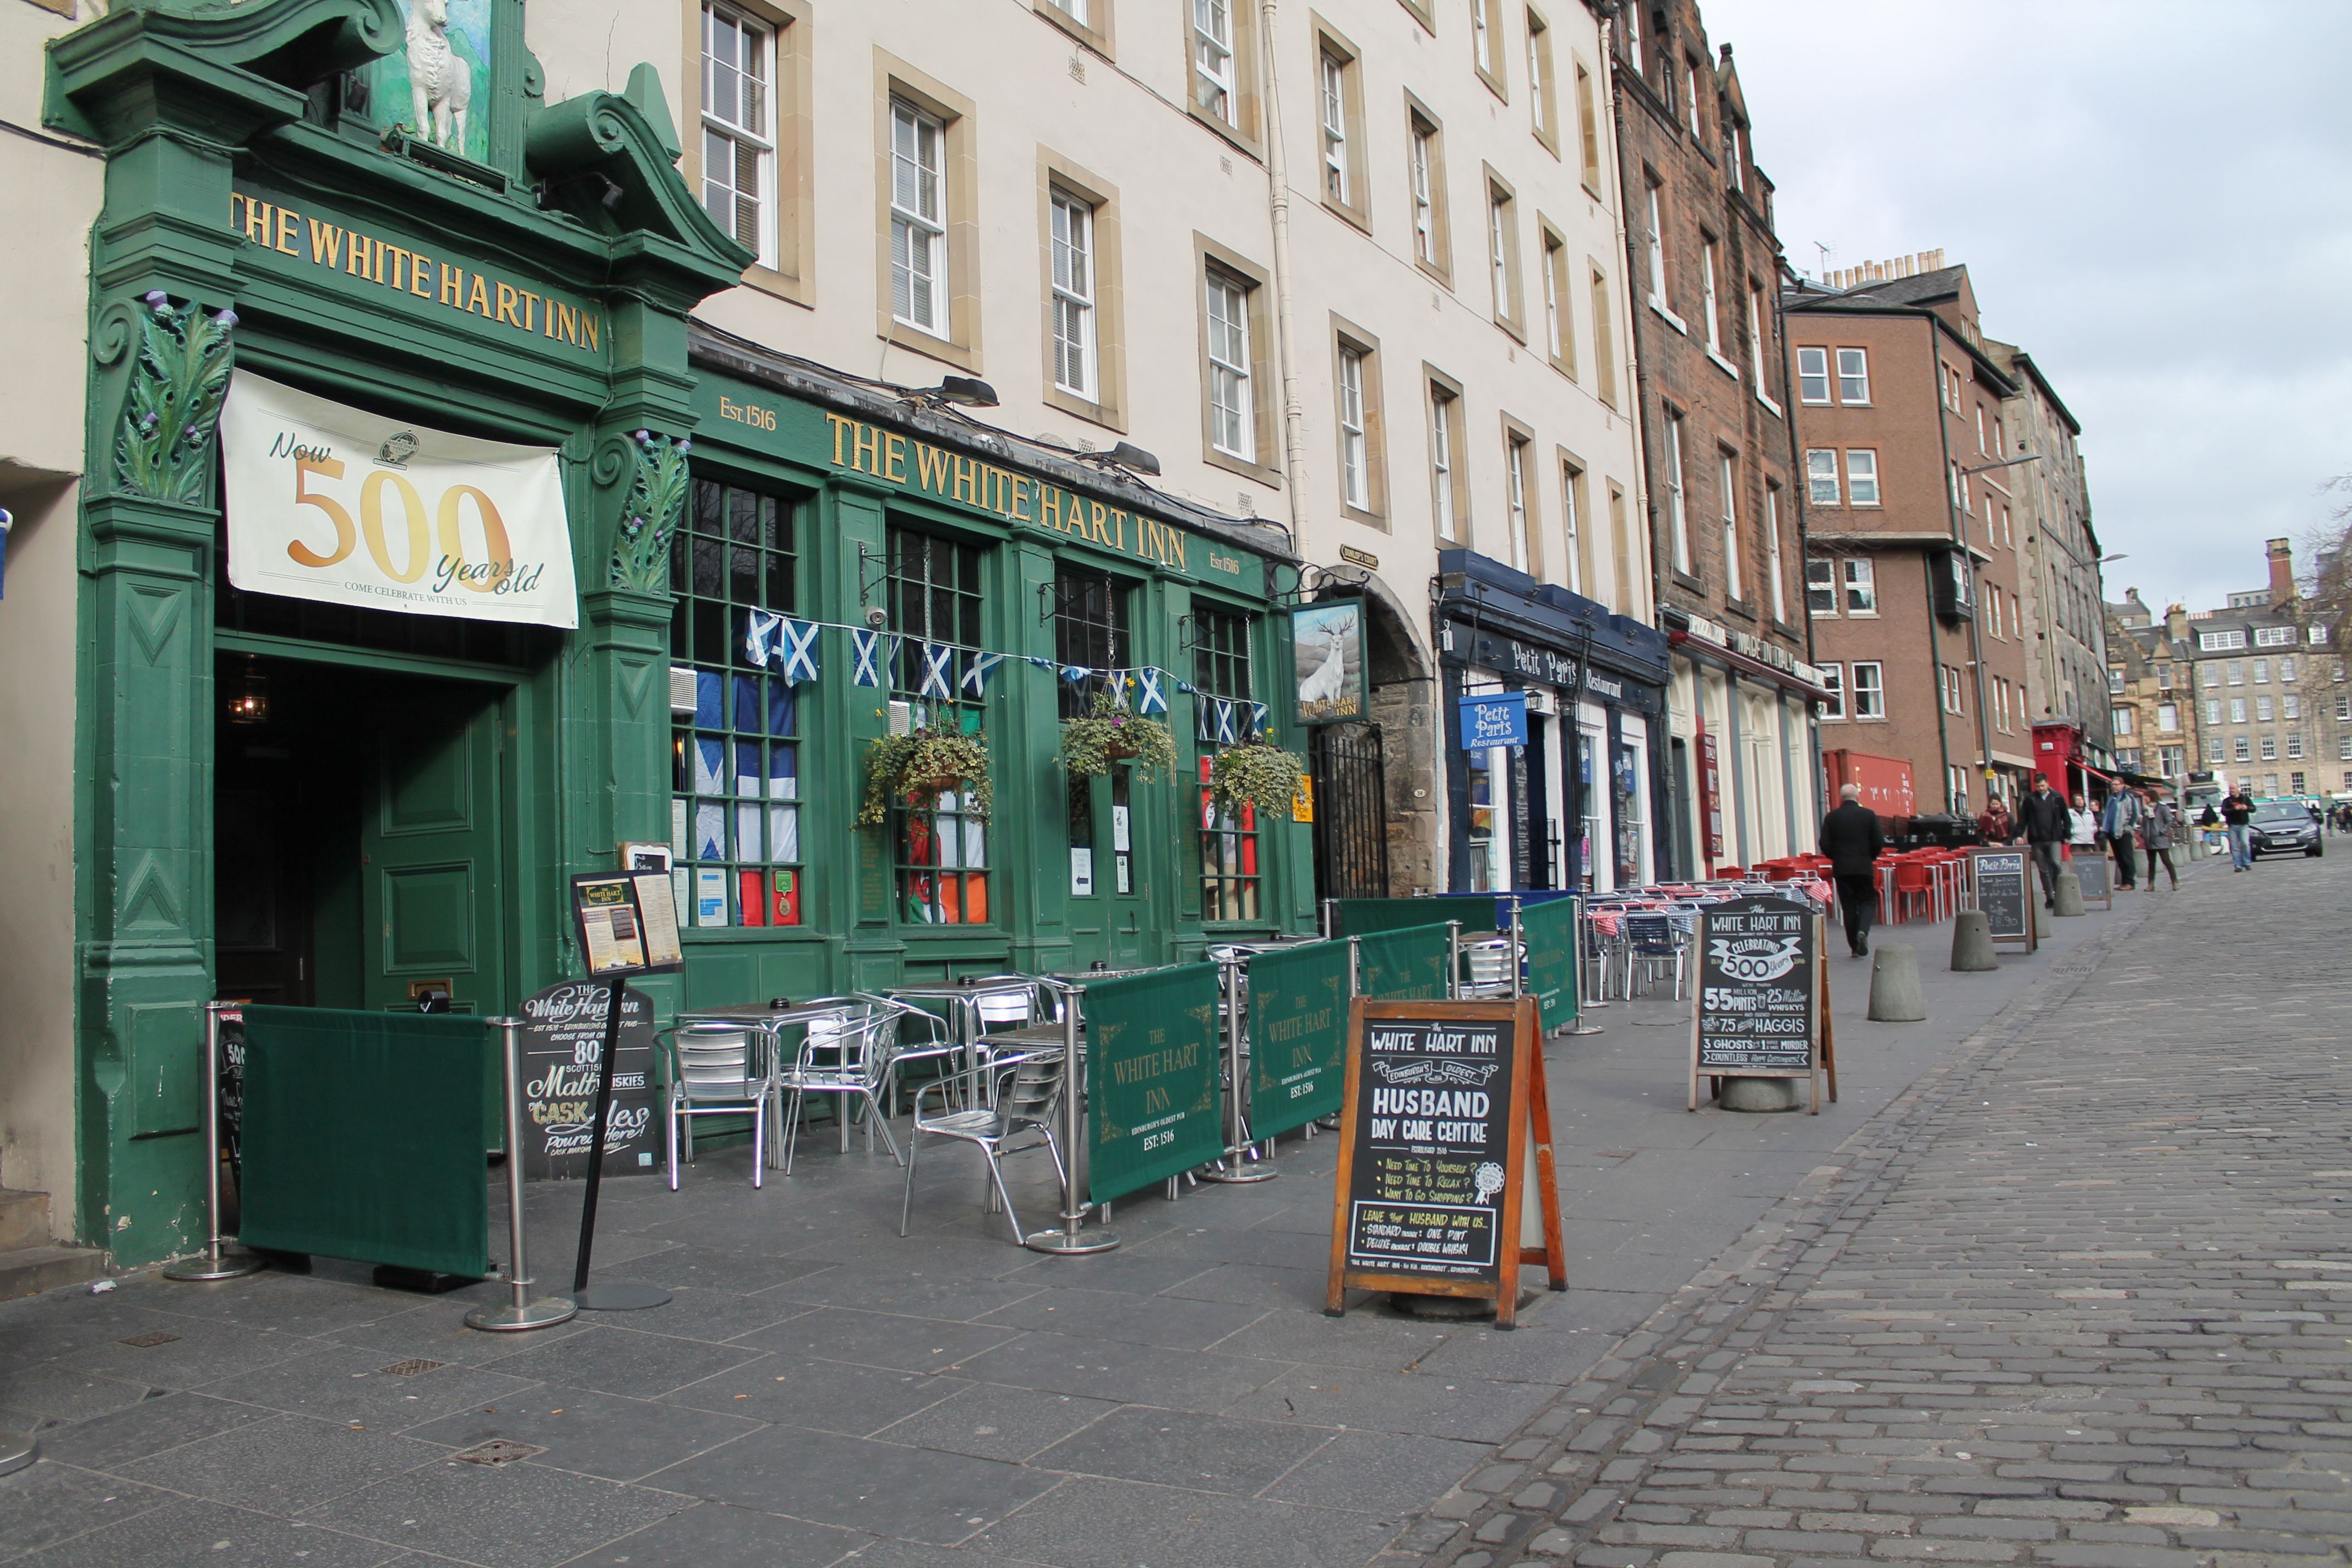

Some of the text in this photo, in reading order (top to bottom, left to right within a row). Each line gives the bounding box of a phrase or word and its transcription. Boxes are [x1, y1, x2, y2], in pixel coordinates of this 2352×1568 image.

[230, 192, 598, 352] THE WHITE HART INN
[746, 406, 776, 431] 1516
[269, 432, 332, 463] Now
[826, 412, 1185, 570] THE WHITE HART INN
[287, 451, 511, 592] 500
[433, 554, 518, 593] Years
[1223, 555, 1240, 575] 1516
[494, 563, 544, 595] old
[345, 581, 467, 606] COME CELEBRATE WITH US
[1738, 631, 1793, 672] MADE IN ITALY
[1512, 641, 1622, 699] Petit Paris Restaurant
[1302, 696, 1357, 717] WHITE HART
[1337, 704, 1357, 716] INN
[1475, 704, 1510, 722] Petit
[1476, 721, 1512, 738] Paris
[1471, 736, 1520, 747] Restaurant
[1979, 858, 1999, 870] Petit
[1749, 905, 1766, 913] The
[1712, 915, 1801, 932] WHITE HART INN
[1732, 938, 1780, 954] CELEBRATING
[1724, 956, 1770, 978] 500
[576, 984, 595, 994] THE
[1704, 987, 1734, 1011] 55
[1767, 988, 1782, 1003] 25
[526, 987, 575, 1018] White
[1295, 995, 1306, 1009] THE
[1733, 997, 1756, 1011] PINTS
[1268, 1008, 1331, 1043] WHITE HART
[1431, 1022, 1442, 1032] The
[1720, 1019, 1805, 1033] 7.5 HAGGIS
[551, 1031, 595, 1041] CHOOSE FROM
[1149, 1028, 1165, 1044] THE
[1371, 1032, 1496, 1053] WHITE HART INN
[1703, 1038, 1711, 1049] 3
[1713, 1039, 1753, 1049] GHOSTS
[1762, 1039, 1766, 1050] 1
[1781, 1040, 1809, 1050] MURDER
[574, 1039, 600, 1064] 80
[1293, 1044, 1313, 1068] INN
[1711, 1053, 1748, 1062] COUNTLESS
[1113, 1043, 1199, 1086] WHITE HART
[1390, 1064, 1430, 1081] EDINBURGH'S
[527, 1065, 597, 1098] Malt
[1291, 1081, 1314, 1099] EST: 1516
[1146, 1087, 1170, 1114] INN
[1373, 1088, 1490, 1118] HUSBAND
[532, 1101, 589, 1124] CASK
[1131, 1112, 1185, 1136] EDINBURGH'S OLDEST PUB
[1371, 1119, 1488, 1143] DAY CARE CENTRE
[1144, 1129, 1174, 1151] EST: 1516
[1386, 1158, 1402, 1170] NEED
[1405, 1159, 1419, 1172] TIME
[1423, 1159, 1431, 1172] TO
[1385, 1173, 1402, 1185] NEED
[1406, 1174, 1421, 1186] TIME
[1425, 1175, 1432, 1187] TO
[1437, 1176, 1461, 1189] RELAX
[1385, 1187, 1402, 1200] WANT
[1405, 1189, 1412, 1201] TO
[1415, 1190, 1425, 1201] GO
[1363, 1210, 1385, 1222] LEAVE
[1409, 1212, 1449, 1226] HUSBAND
[1452, 1215, 1471, 1228] WITH
[1366, 1224, 1401, 1237] STANDARD
[1427, 1228, 1442, 1239] ONE
[1447, 1229, 1468, 1241] PINT
[1366, 1237, 1391, 1249] DELUXE
[1417, 1242, 1440, 1253] DOUBLE
[1442, 1243, 1468, 1255] WHISKY
